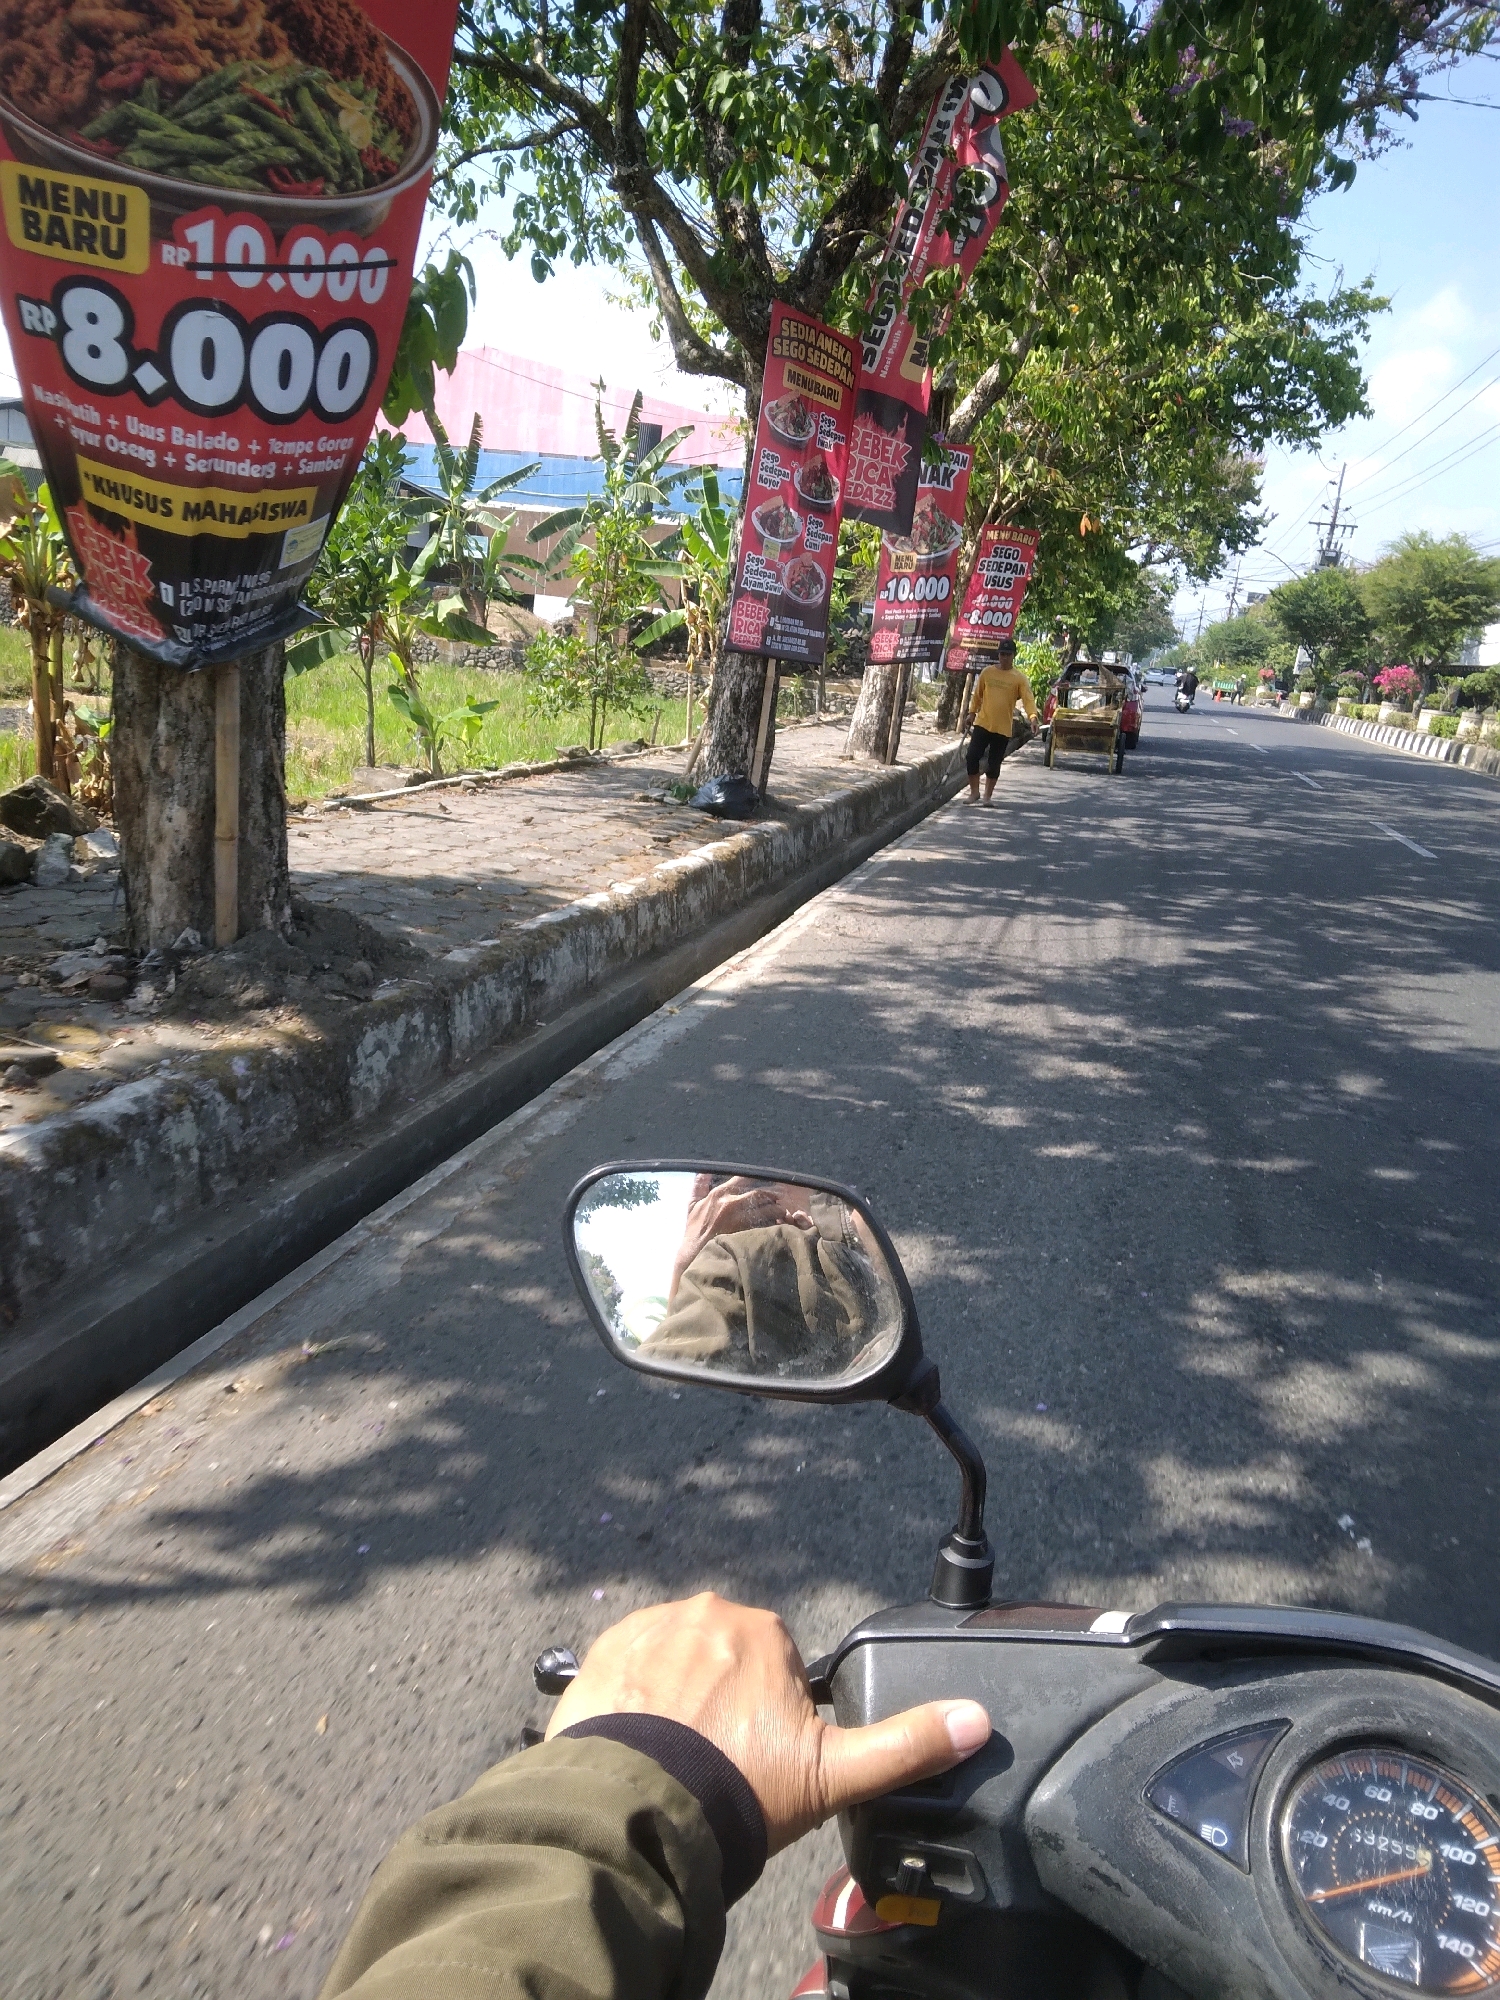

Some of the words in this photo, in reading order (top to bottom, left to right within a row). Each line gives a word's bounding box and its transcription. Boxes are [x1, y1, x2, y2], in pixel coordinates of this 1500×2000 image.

[18, 173, 126, 225] MENU
[20, 207, 126, 260] BARU
[184, 219, 390, 304] 10.000
[61, 286, 371, 414] 8.000
[781, 319, 816, 346] SEDIA
[816, 332, 852, 368] ANEKA
[773, 337, 806, 361] SEGO
[806, 347, 855, 390] SEDEPAN
[820, 413, 836, 428] Sego
[126, 415, 166, 442] Usus
[171, 426, 240, 452] Balado
[268, 438, 314, 457] Tempe
[819, 425, 845, 444] Sedepan
[68, 424, 101, 447] ayur
[298, 454, 346, 474] Sambel
[762, 450, 780, 463] Sego
[760, 462, 790, 480] Sedepan
[844, 480, 895, 509] EDAZZ
[182, 499, 308, 526] MAHASISWA
[808, 515, 824, 528] Sego
[805, 539, 820, 551] Cumi
[807, 528, 833, 543] Sedepan
[986, 530, 1011, 542] MENU
[1011, 531, 1036, 546] BARU
[747, 553, 765, 566] Sego
[895, 554, 914, 562] MENU
[992, 546, 1020, 561] SEGO
[745, 565, 776, 580] Sedepan
[894, 562, 913, 570] BARU
[978, 559, 1027, 577] SEDEPAN
[743, 577, 764, 590] Ayam
[887, 576, 950, 602] 10.000
[984, 574, 1013, 589] USUS
[736, 601, 771, 624] BEBEK
[969, 609, 1013, 628] 8.000
[735, 617, 761, 637] RICA
[1322, 1793, 1350, 1811] 40
[1364, 1785, 1392, 1802] 60
[1411, 1802, 1438, 1820] 80
[1300, 1829, 1328, 1848] 20
[1440, 1844, 1477, 1865] 100
[1452, 1894, 1490, 1917] 120
[1437, 1935, 1476, 1958] 140
